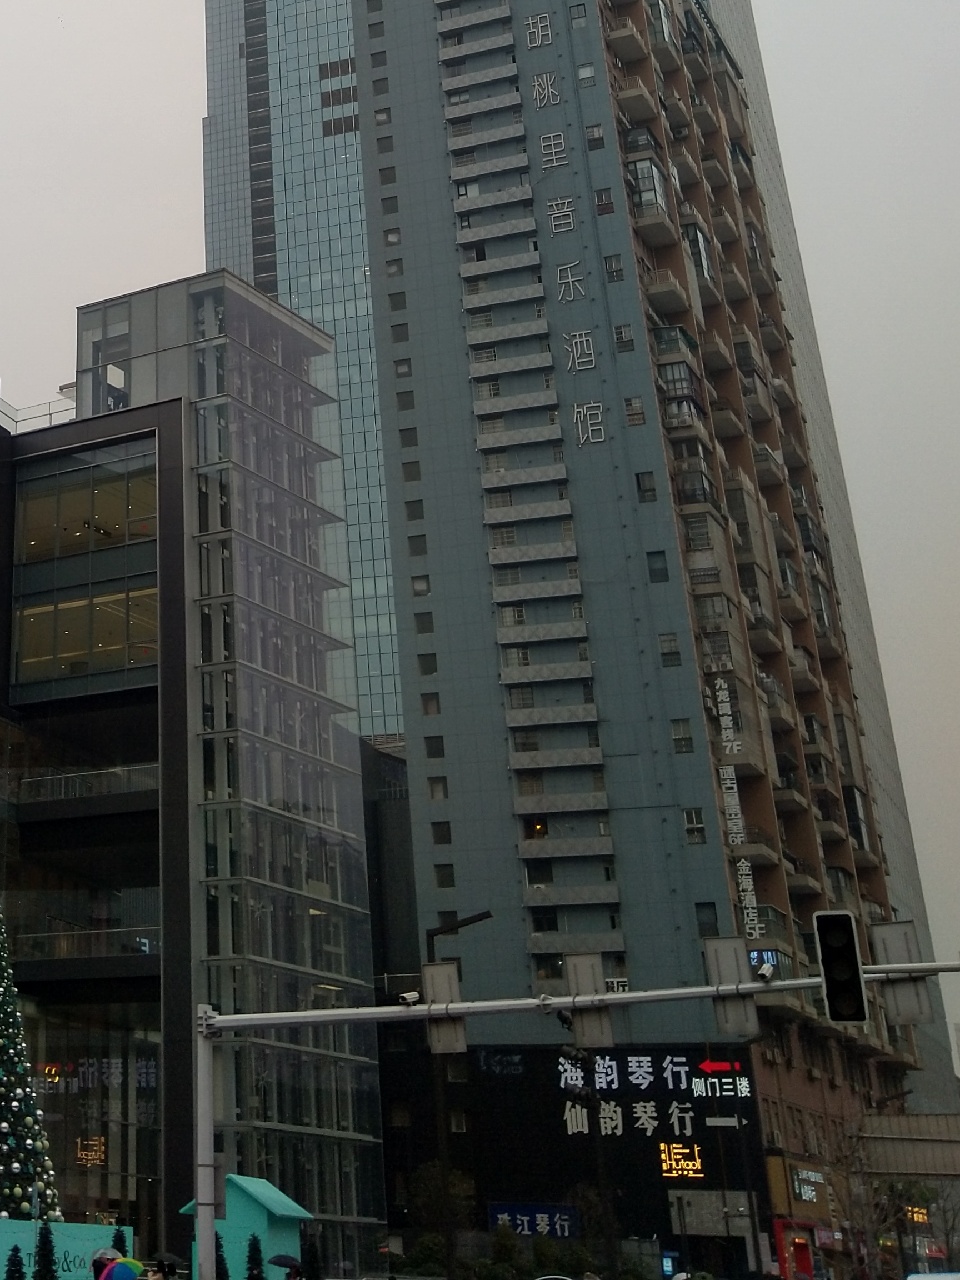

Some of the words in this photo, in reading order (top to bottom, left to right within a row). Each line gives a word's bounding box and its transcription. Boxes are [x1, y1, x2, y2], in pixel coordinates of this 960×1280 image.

[524, 14, 606, 445] 胡桃里音乐酒馆
[722, 741, 742, 754] 7F
[746, 924, 766, 940] 5F
[558, 1055, 689, 1089] 海韵琴行
[692, 1077, 751, 1098] 侧门三楼
[563, 1100, 695, 1136] 仙韵琴行
